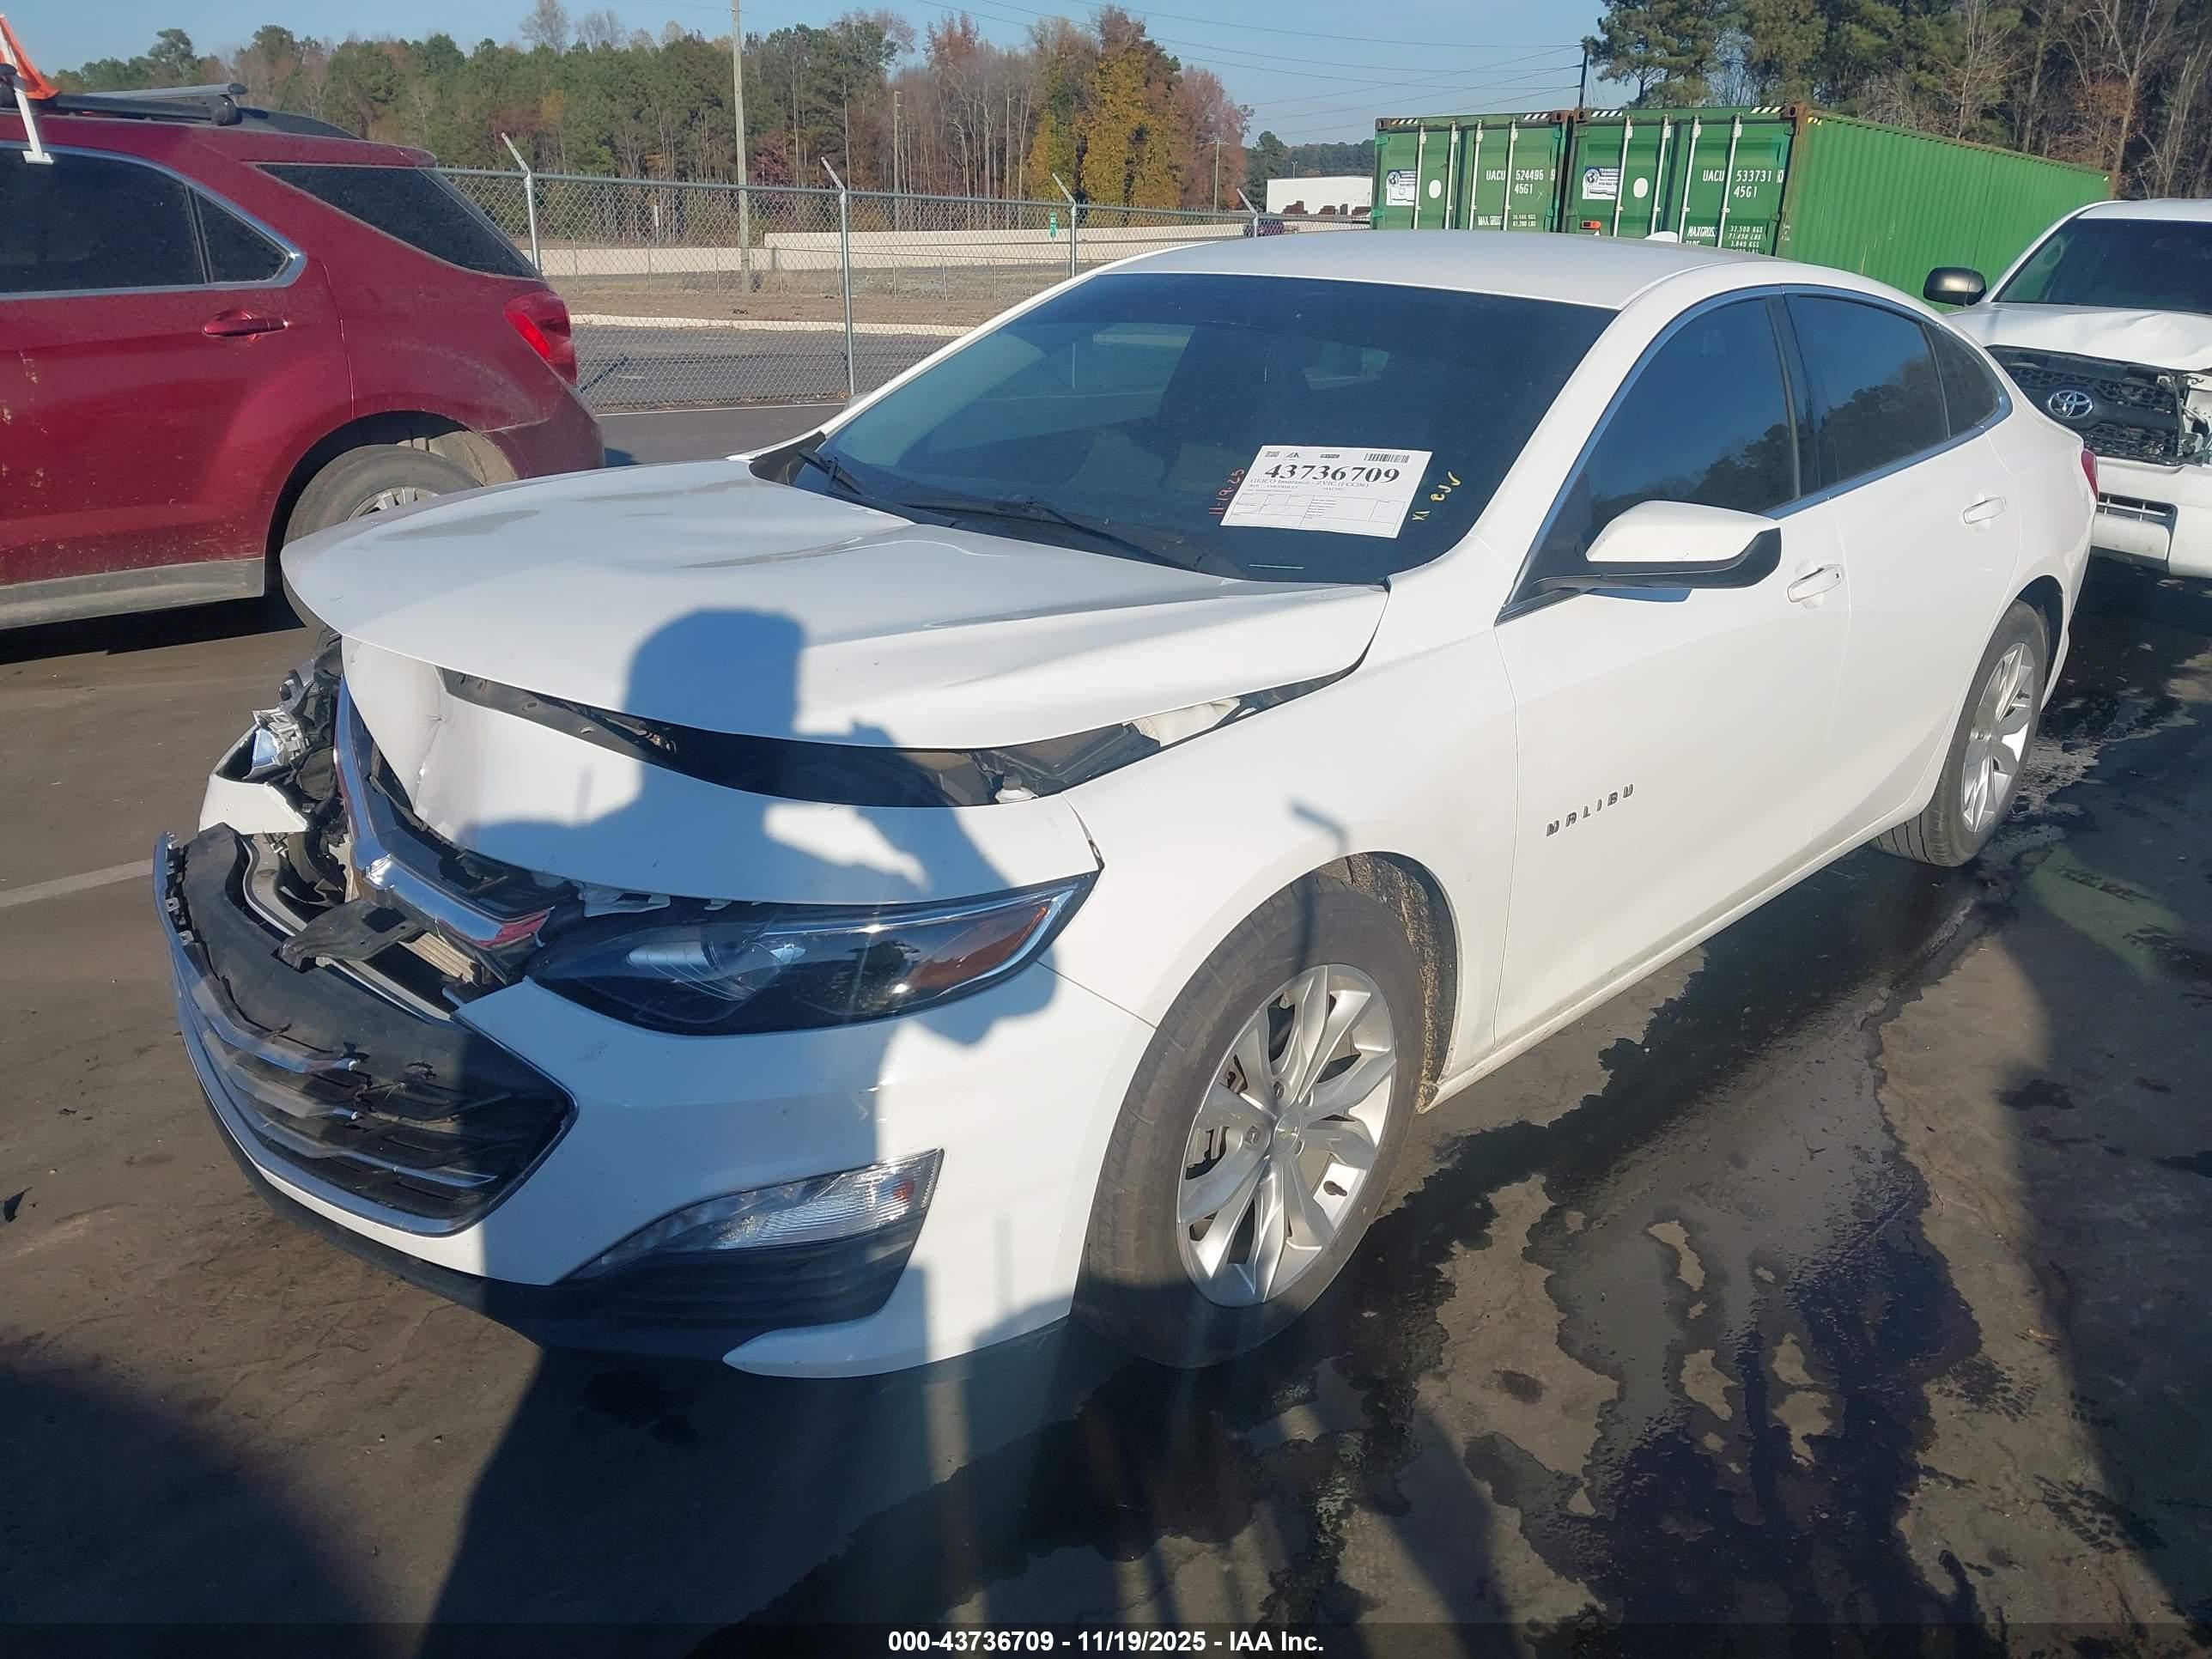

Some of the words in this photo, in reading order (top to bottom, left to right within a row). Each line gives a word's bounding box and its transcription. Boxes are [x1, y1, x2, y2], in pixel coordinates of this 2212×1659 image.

[1486, 169, 1506, 181] UACU
[1550, 167, 1556, 181] 9
[1702, 169, 1725, 182] UACU
[1735, 169, 1772, 182] 533731
[1514, 182, 1534, 195] 45G1
[1733, 185, 1758, 198] 45G1
[1686, 226, 1701, 237] MAX
[1264, 463, 1401, 483] 43736709
[1546, 783, 1634, 837] MALIBU
